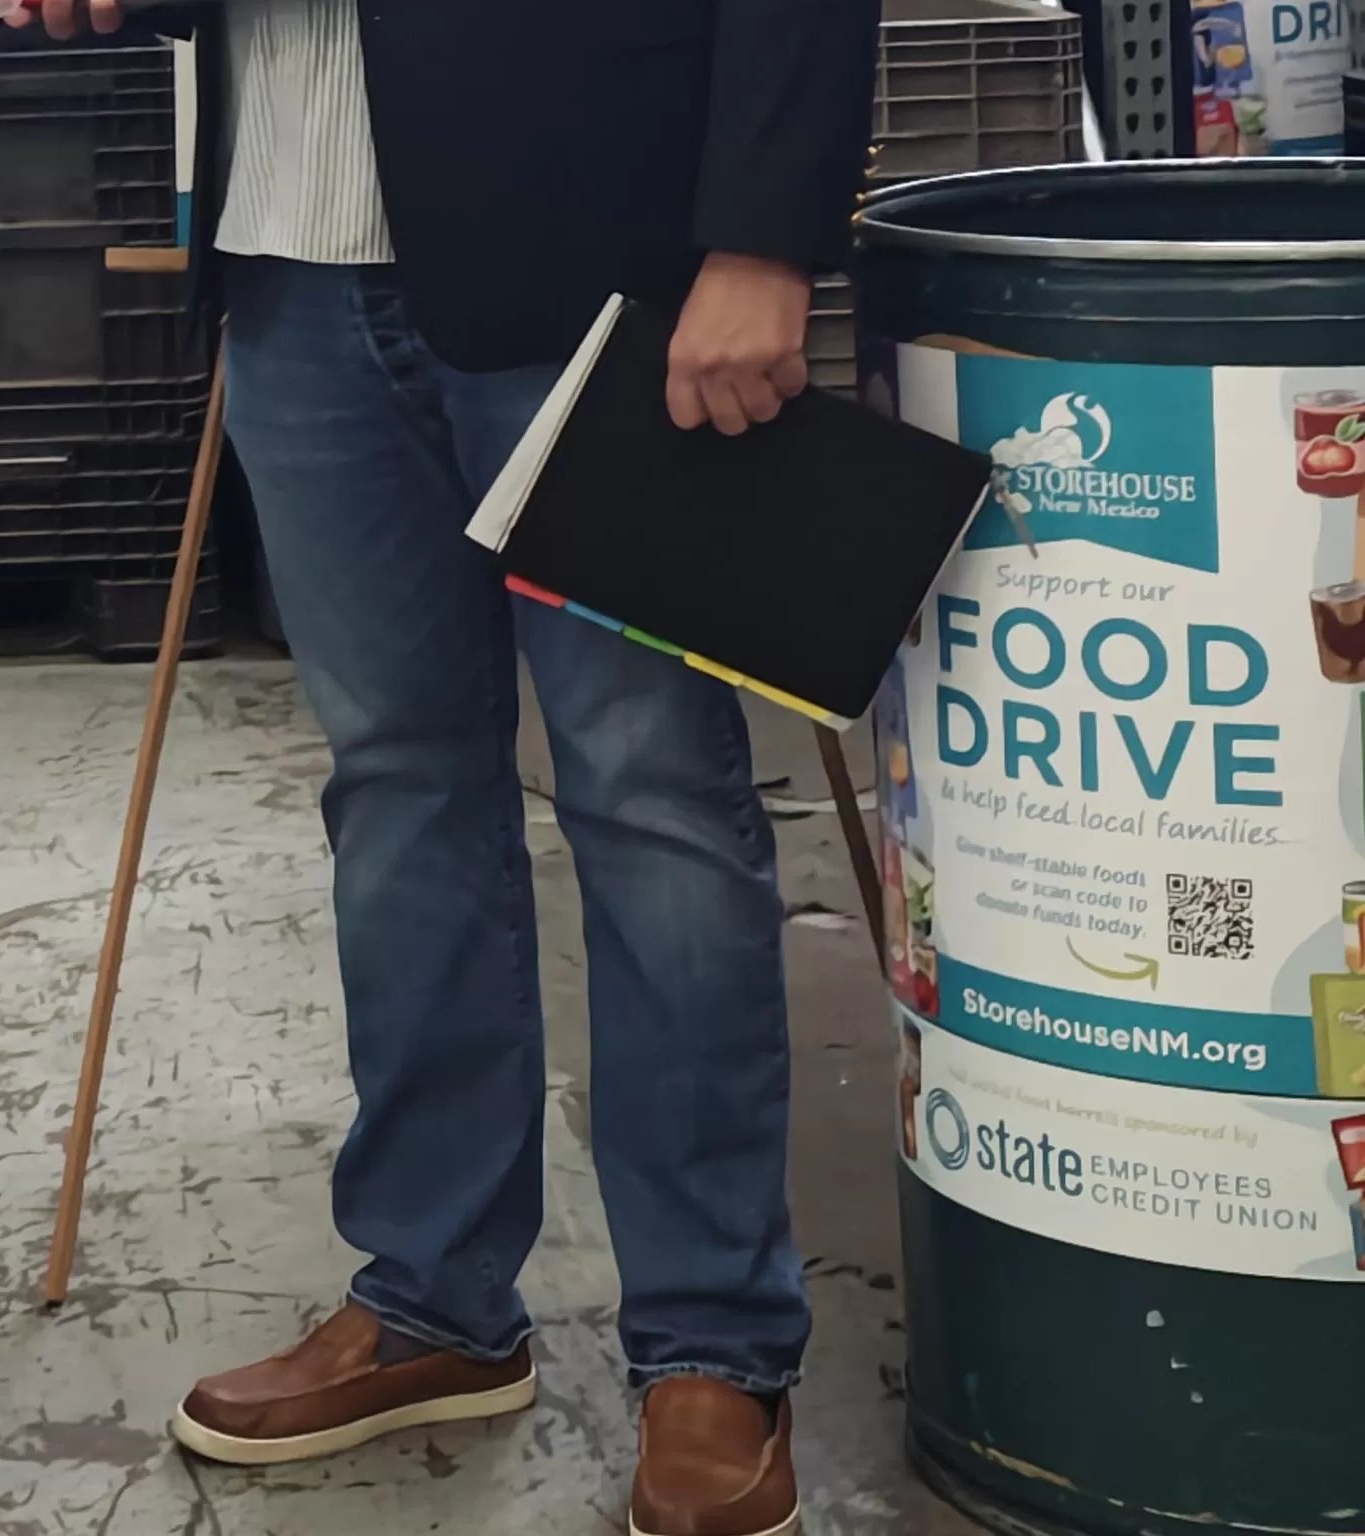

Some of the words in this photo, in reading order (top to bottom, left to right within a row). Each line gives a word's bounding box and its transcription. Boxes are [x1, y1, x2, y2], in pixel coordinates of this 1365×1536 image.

[1016, 466, 1197, 502] STOREHOUSE
[1039, 493, 1081, 512] New
[1087, 498, 1160, 518] Mexico
[996, 564, 1112, 602] Support
[1122, 581, 1175, 602] our
[937, 593, 1269, 707] FOOD
[936, 684, 1283, 807] DRIVE
[962, 779, 1007, 815] help
[1017, 792, 1073, 825] feed
[1081, 803, 1144, 837] local
[1157, 810, 1279, 846] families
[1077, 891, 1122, 909] code
[1093, 865, 1146, 887] foods
[963, 987, 1267, 1071] StorehouseNM.org
[976, 1119, 1084, 1197] state
[1090, 1154, 1272, 1199] EMPLOYEES
[1091, 1183, 1202, 1221] CREDIT
[1216, 1201, 1319, 1232] UNION
